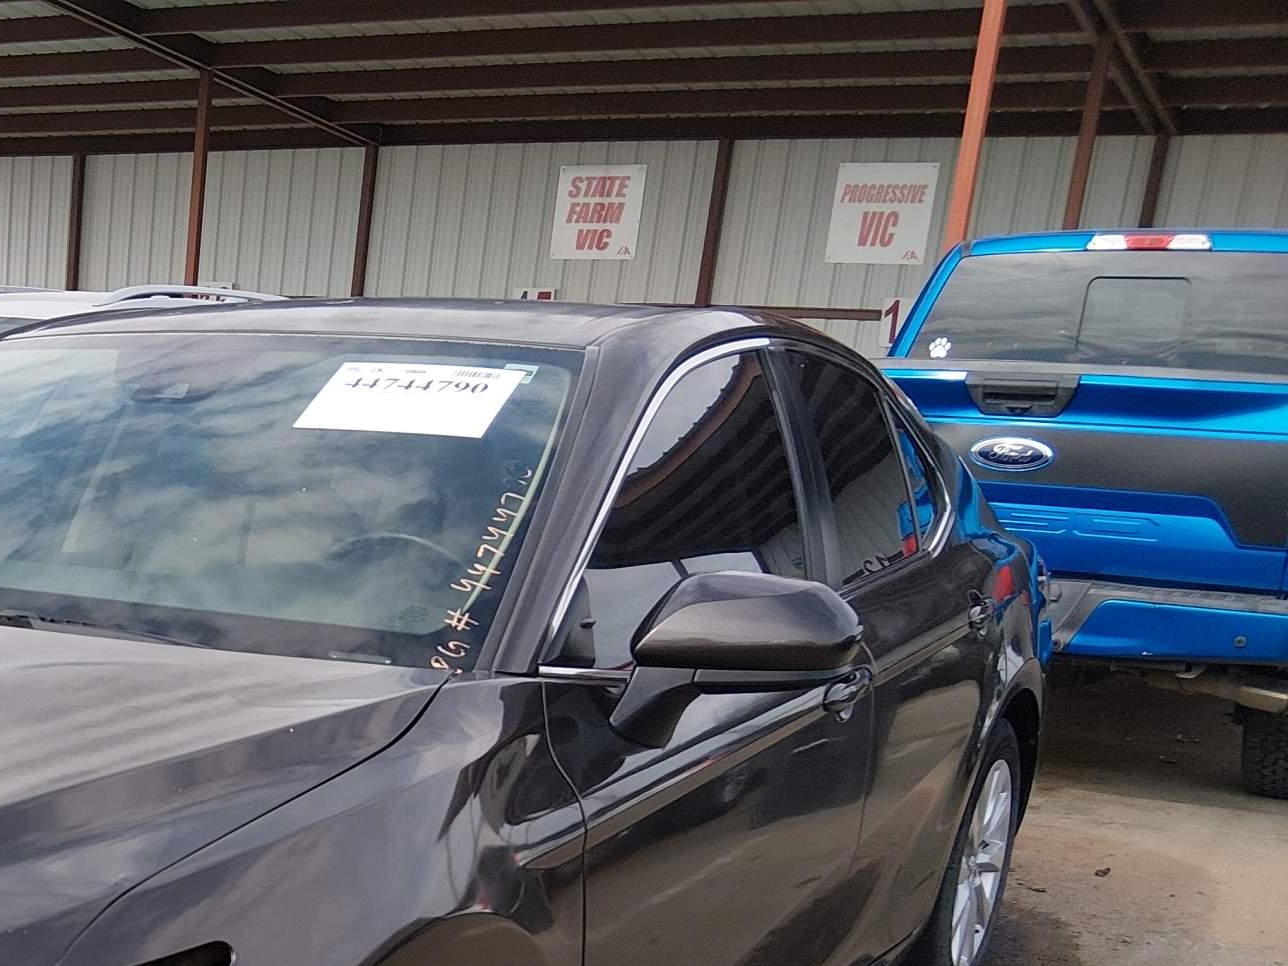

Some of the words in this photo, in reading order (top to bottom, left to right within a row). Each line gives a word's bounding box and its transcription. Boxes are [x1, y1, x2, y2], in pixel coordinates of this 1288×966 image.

[568, 175, 631, 198] STATE
[840, 183, 928, 204] PROGRESSIVE
[565, 202, 626, 224] FARM
[575, 228, 612, 250] VIC
[857, 211, 899, 247] VIC
[345, 377, 489, 393] 44744790
